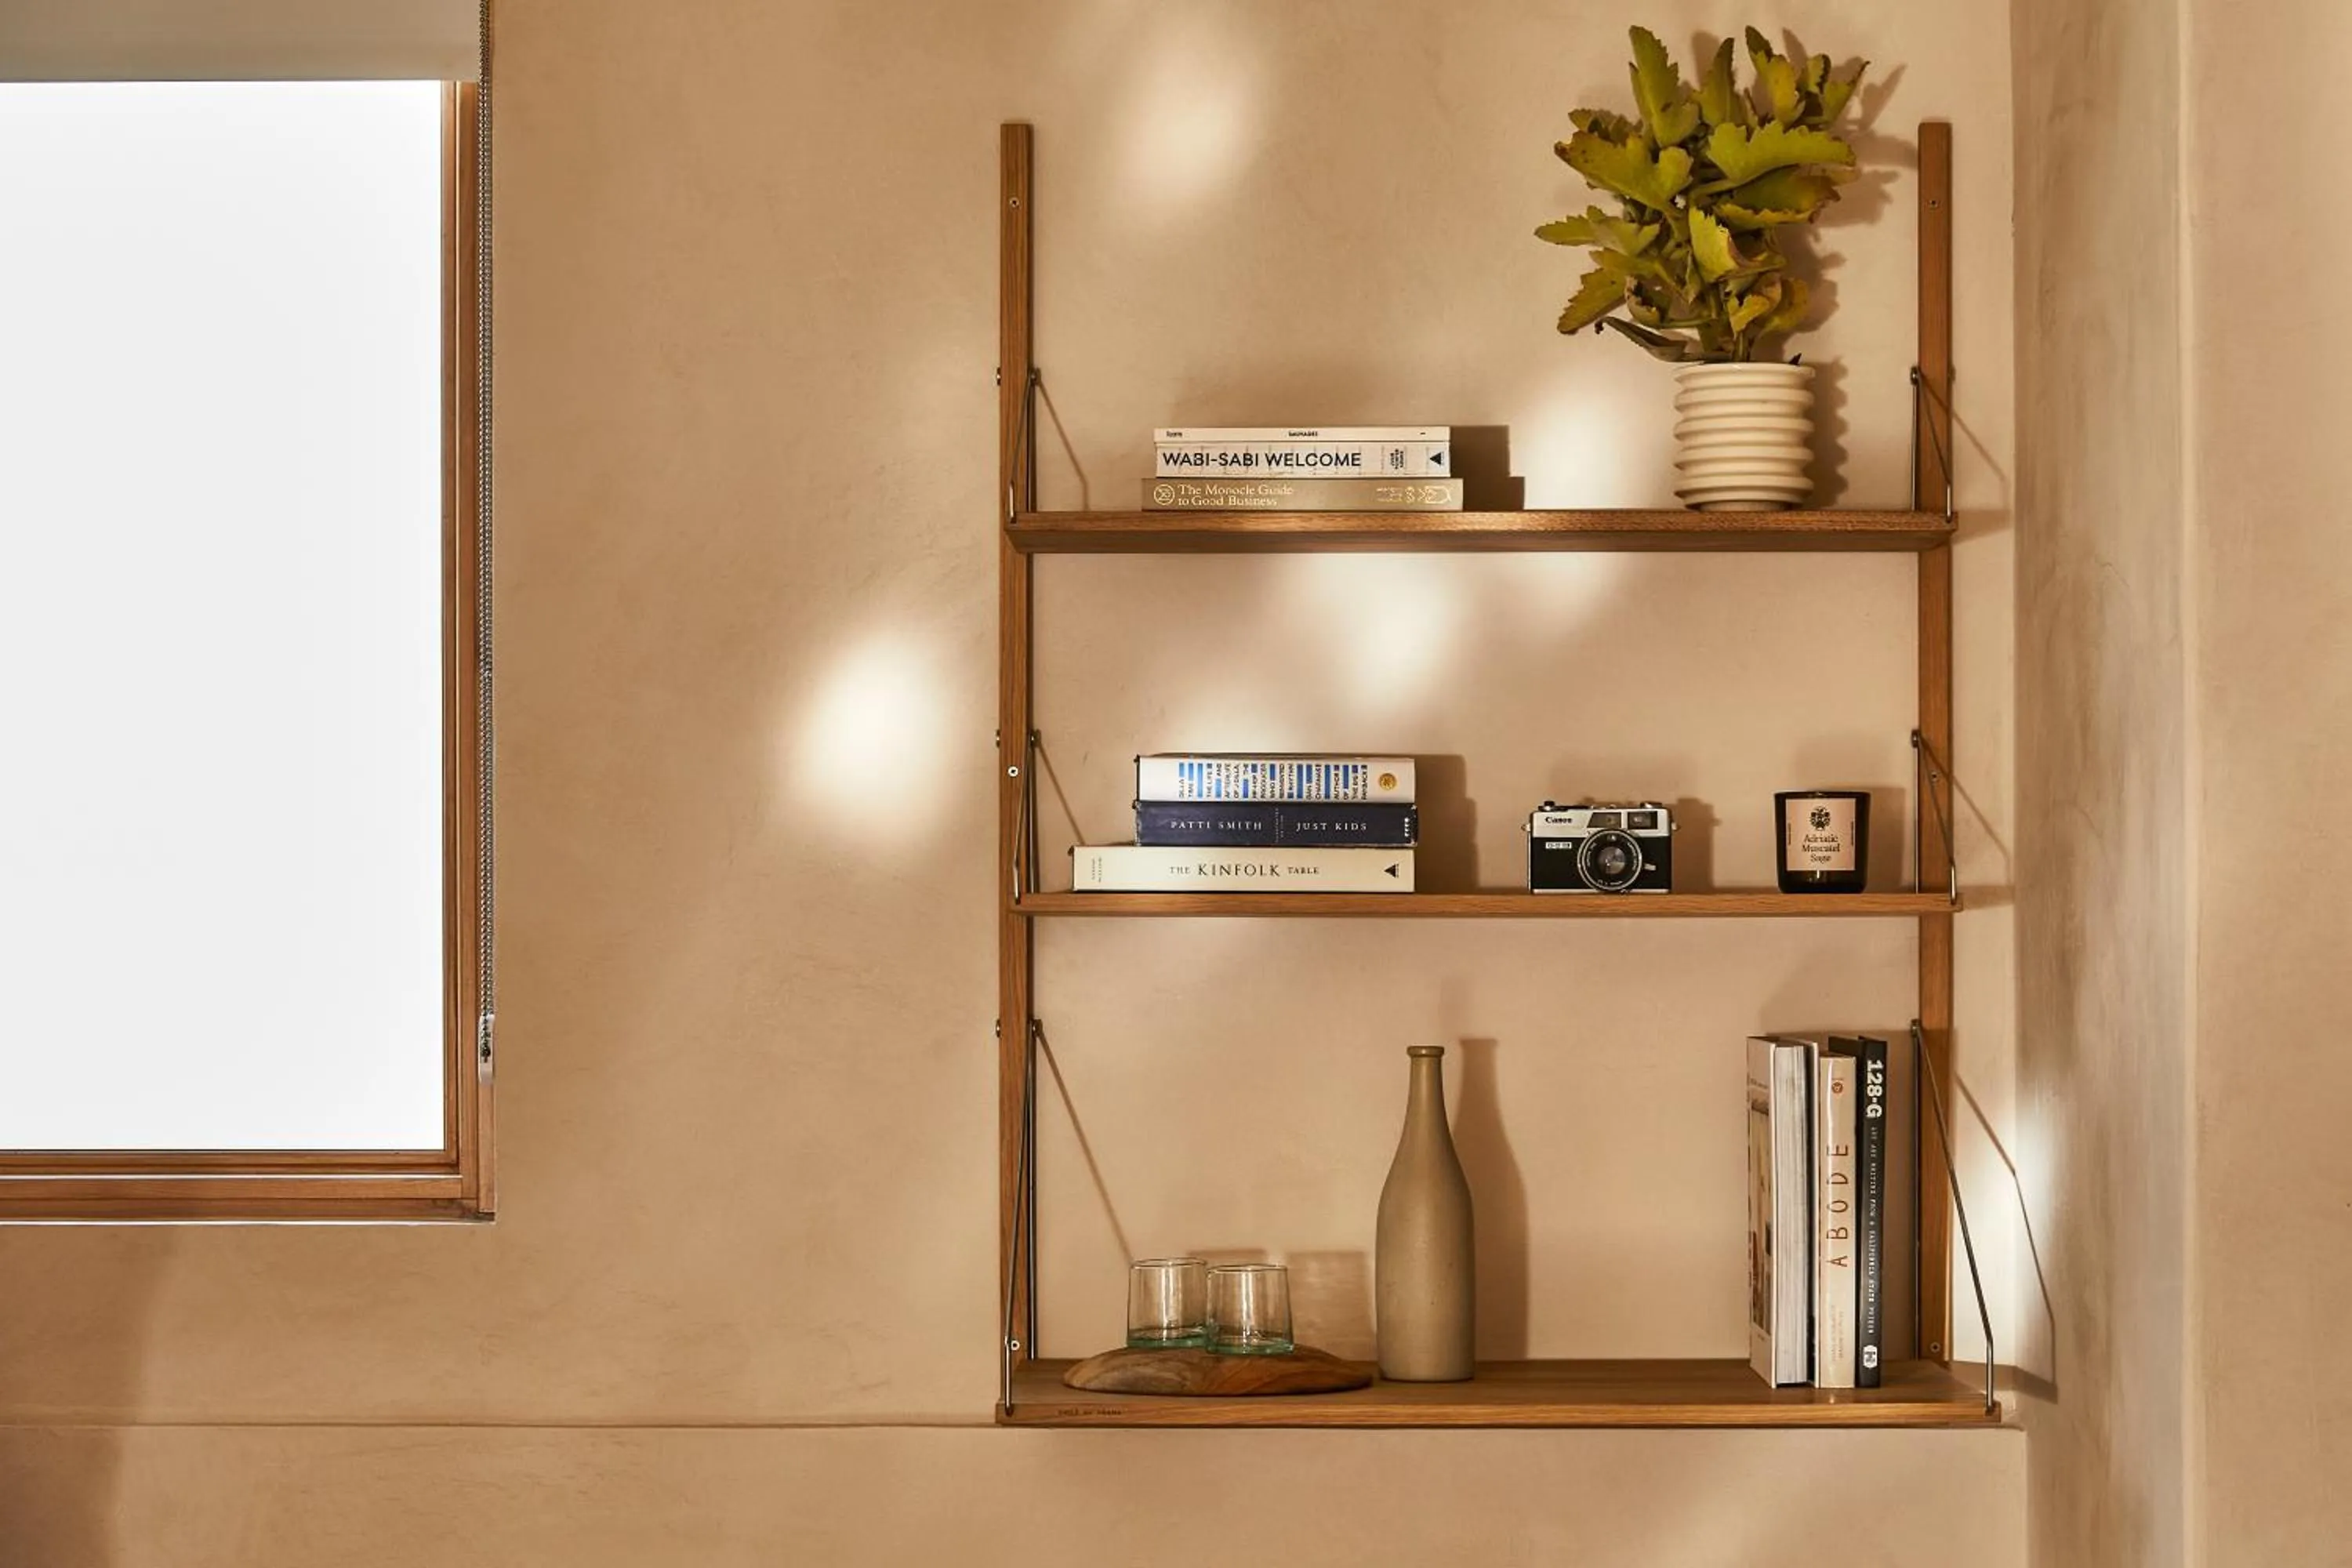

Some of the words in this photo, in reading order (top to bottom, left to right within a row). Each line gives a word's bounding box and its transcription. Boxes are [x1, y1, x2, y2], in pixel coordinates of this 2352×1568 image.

[1163, 452, 1258, 466] WABI-SABI
[1265, 452, 1362, 466] WELCOME
[1178, 484, 1201, 495] The
[1206, 484, 1254, 495] Monocle
[1258, 484, 1294, 495] Guide
[1178, 497, 1189, 506] to
[1192, 496, 1224, 506] Good
[1229, 496, 1277, 506] Business
[1218, 821, 1262, 830] SMITH
[1296, 822, 1328, 832] JUST
[1804, 834, 1838, 843] Adriatic
[1198, 863, 1280, 877] KINFOLK
[1827, 1145, 1849, 1267] ABODE
